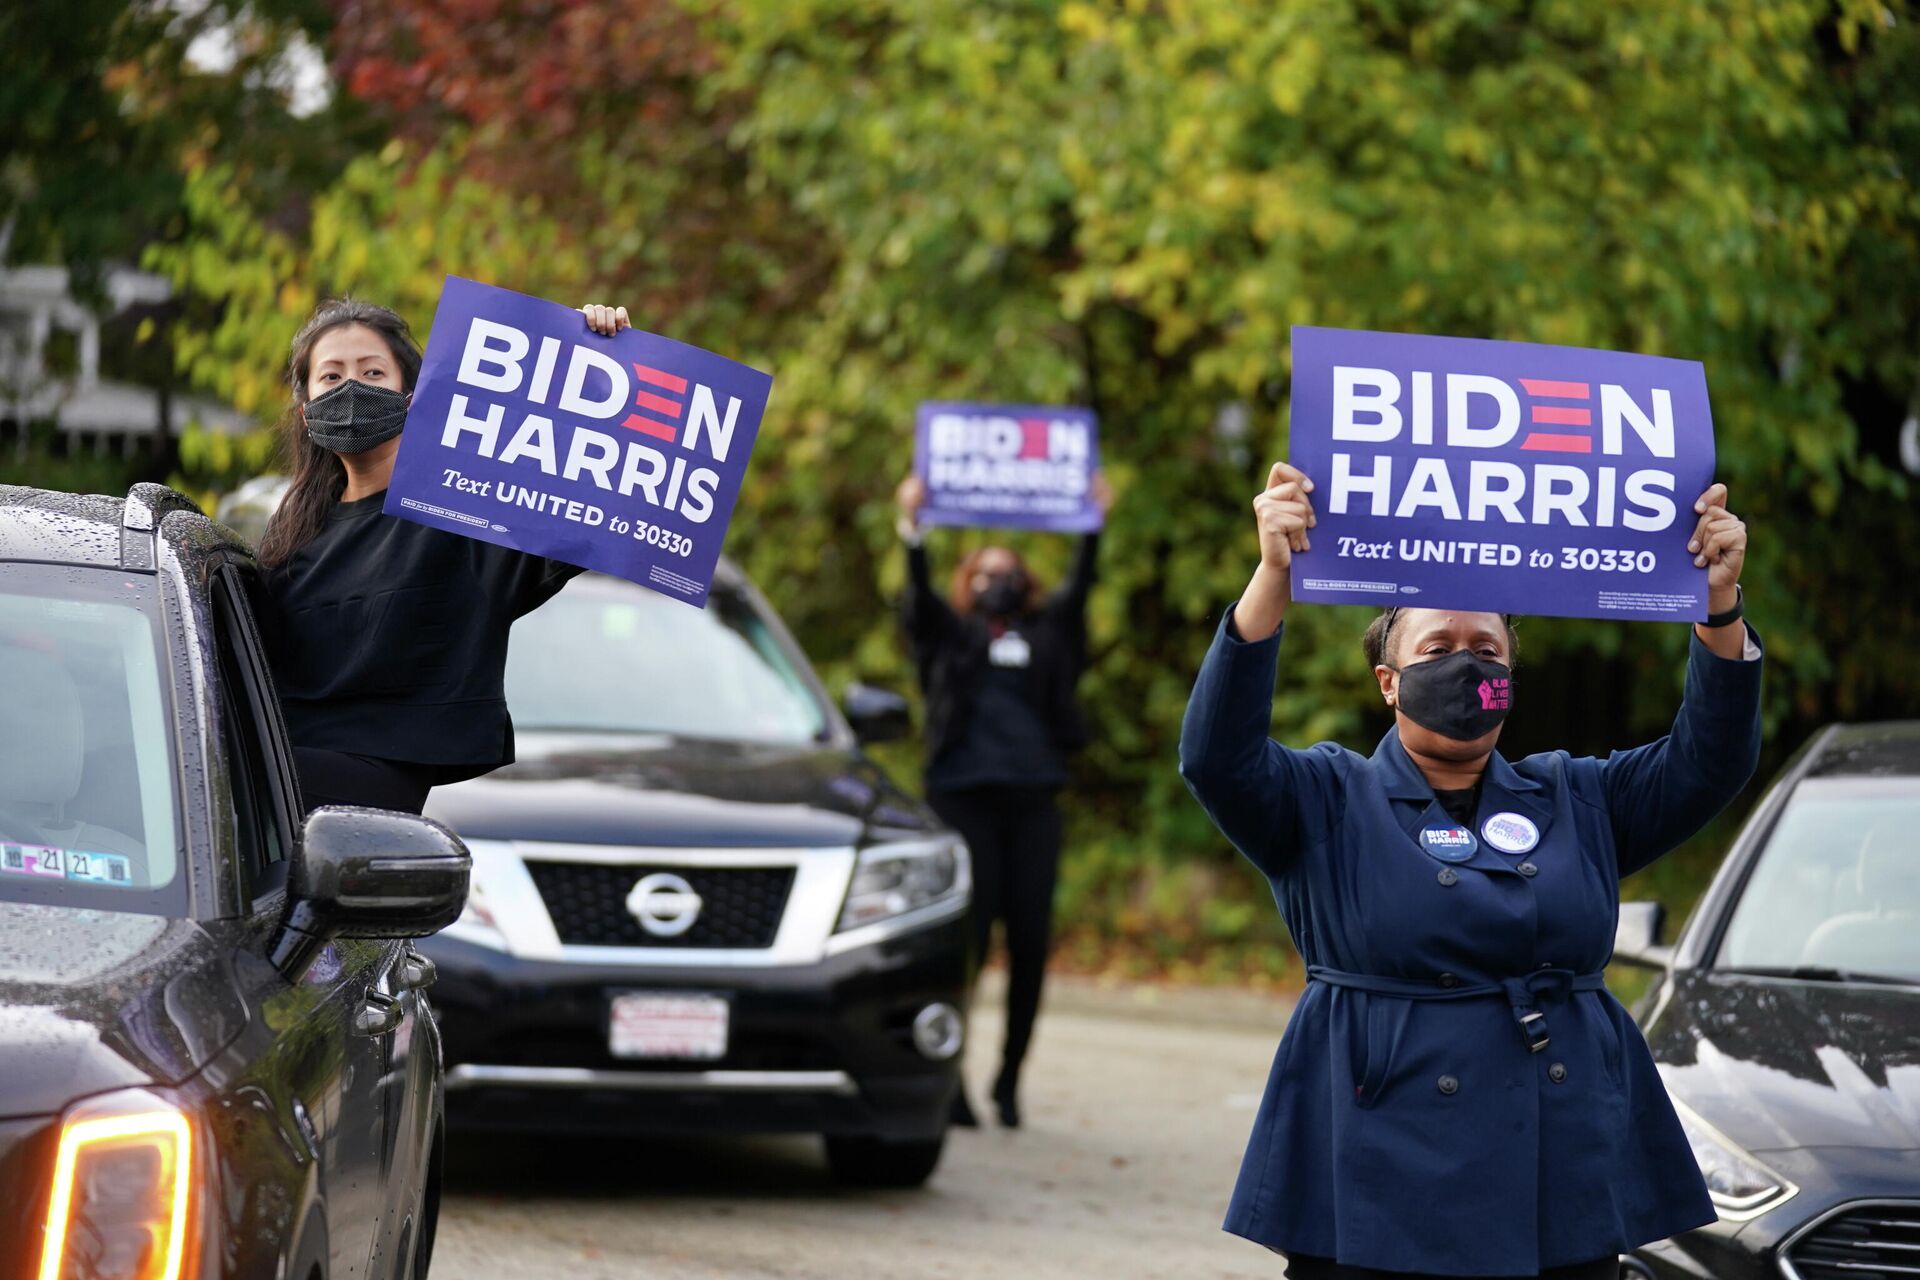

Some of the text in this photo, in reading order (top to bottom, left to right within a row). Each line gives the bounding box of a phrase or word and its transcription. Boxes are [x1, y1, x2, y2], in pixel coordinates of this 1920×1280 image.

[456, 317, 742, 463] BIDEN
[1332, 365, 1676, 458] BIDEN
[440, 393, 720, 523] HARRIS
[1329, 453, 1677, 532] HARRIS
[442, 469, 693, 558] Text UNITED to 30330
[456, 513, 487, 526] PRESIDENT
[1338, 537, 1657, 573] Text UNITED to 30330
[1425, 829, 1468, 838] BIDEN
[1429, 837, 1471, 845] HARRIS
[43, 849, 61, 871] 21
[73, 855, 91, 875] 21
